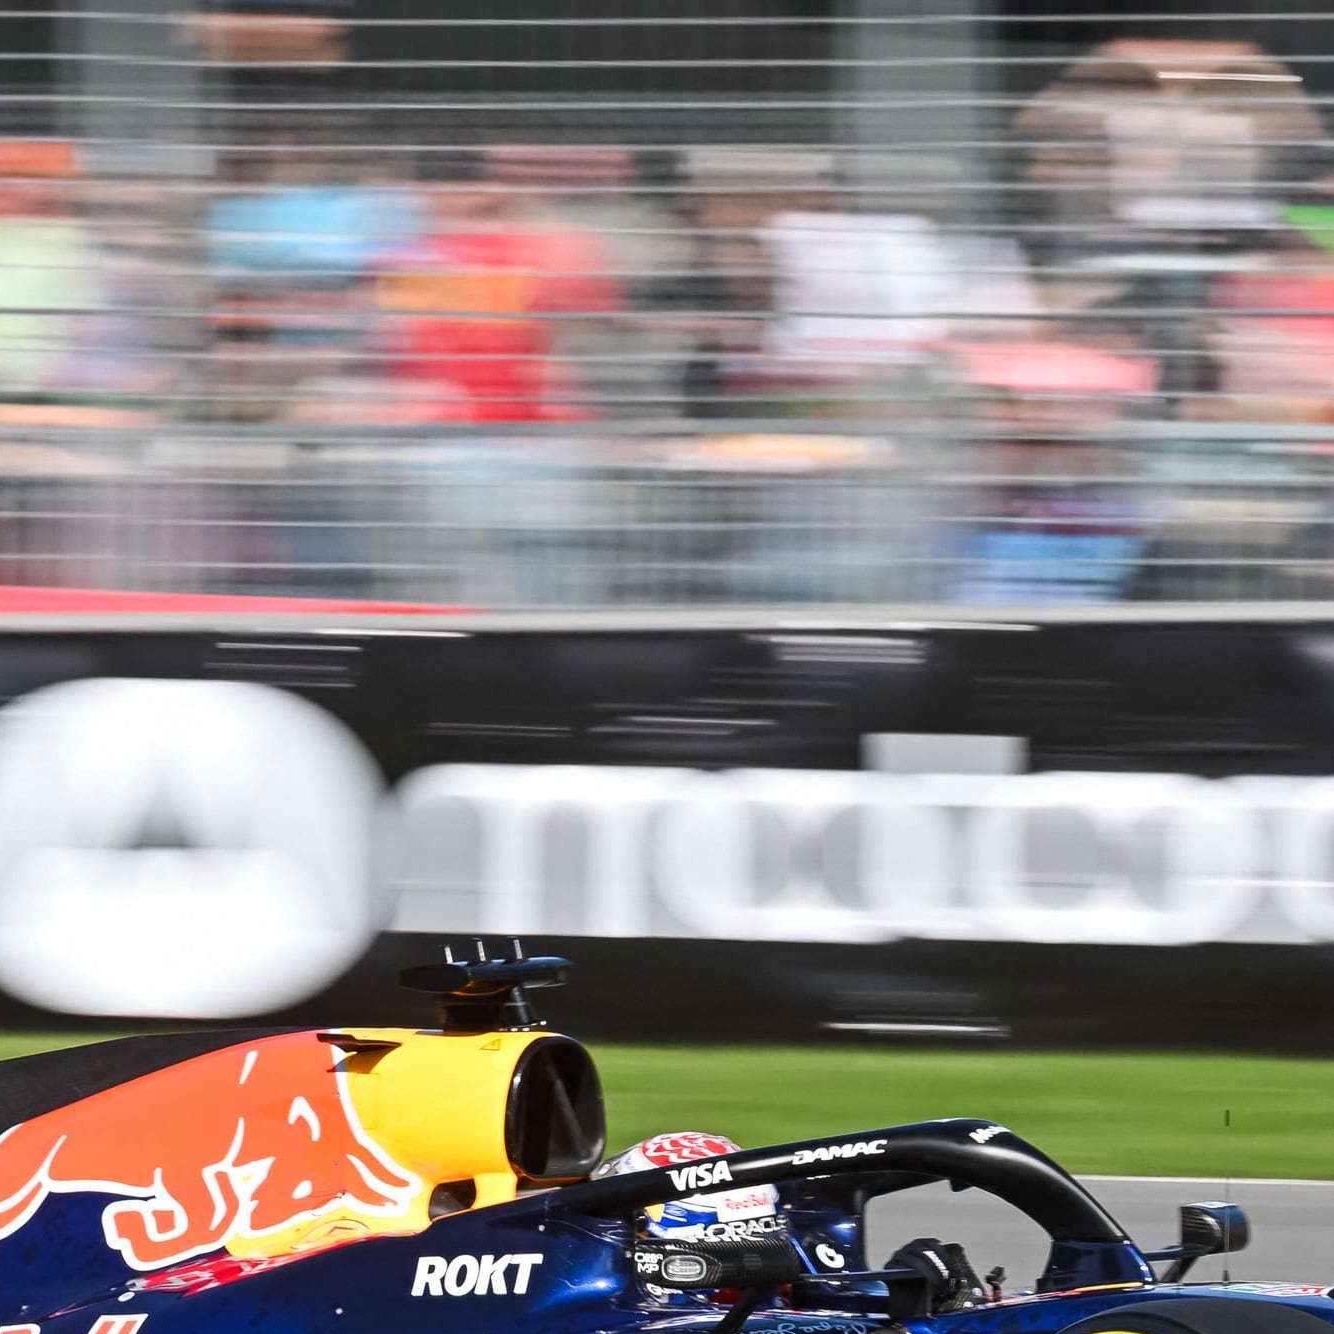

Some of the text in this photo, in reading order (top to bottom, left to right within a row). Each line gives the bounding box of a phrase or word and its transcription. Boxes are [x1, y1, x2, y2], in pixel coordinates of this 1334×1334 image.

[792, 1139, 887, 1165] DAMAC
[666, 1160, 734, 1191] VISA
[411, 1253, 544, 1297] ROKT
